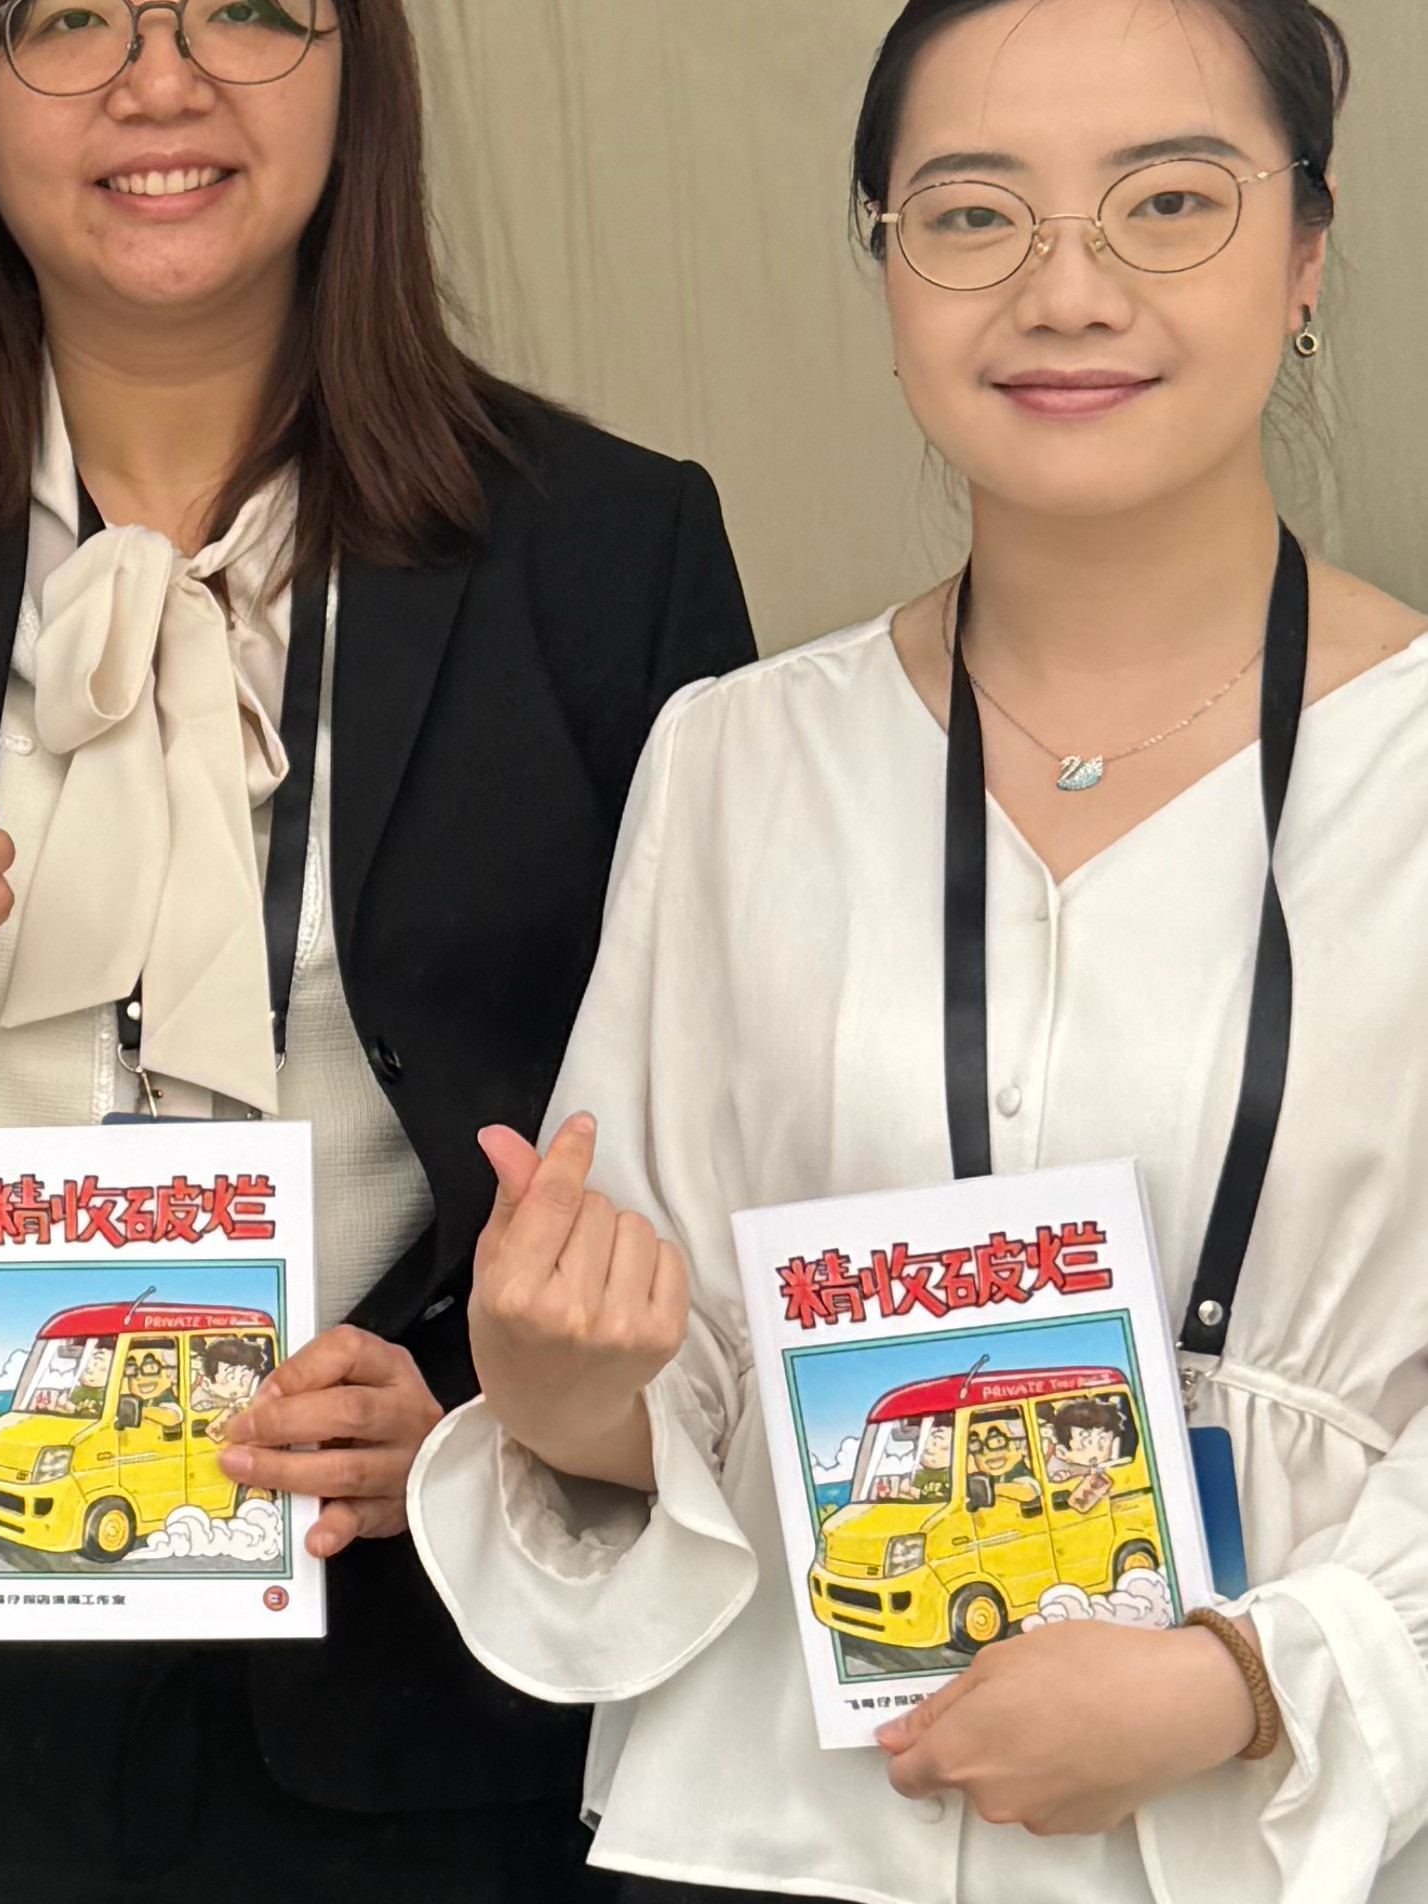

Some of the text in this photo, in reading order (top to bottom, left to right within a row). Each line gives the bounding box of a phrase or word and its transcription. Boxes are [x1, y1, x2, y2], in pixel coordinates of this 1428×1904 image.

[775, 1220, 1114, 1328] 精收破烂
[144, 1315, 201, 1328] PRIVATE
[982, 1380, 1045, 1400] PRIVATE
